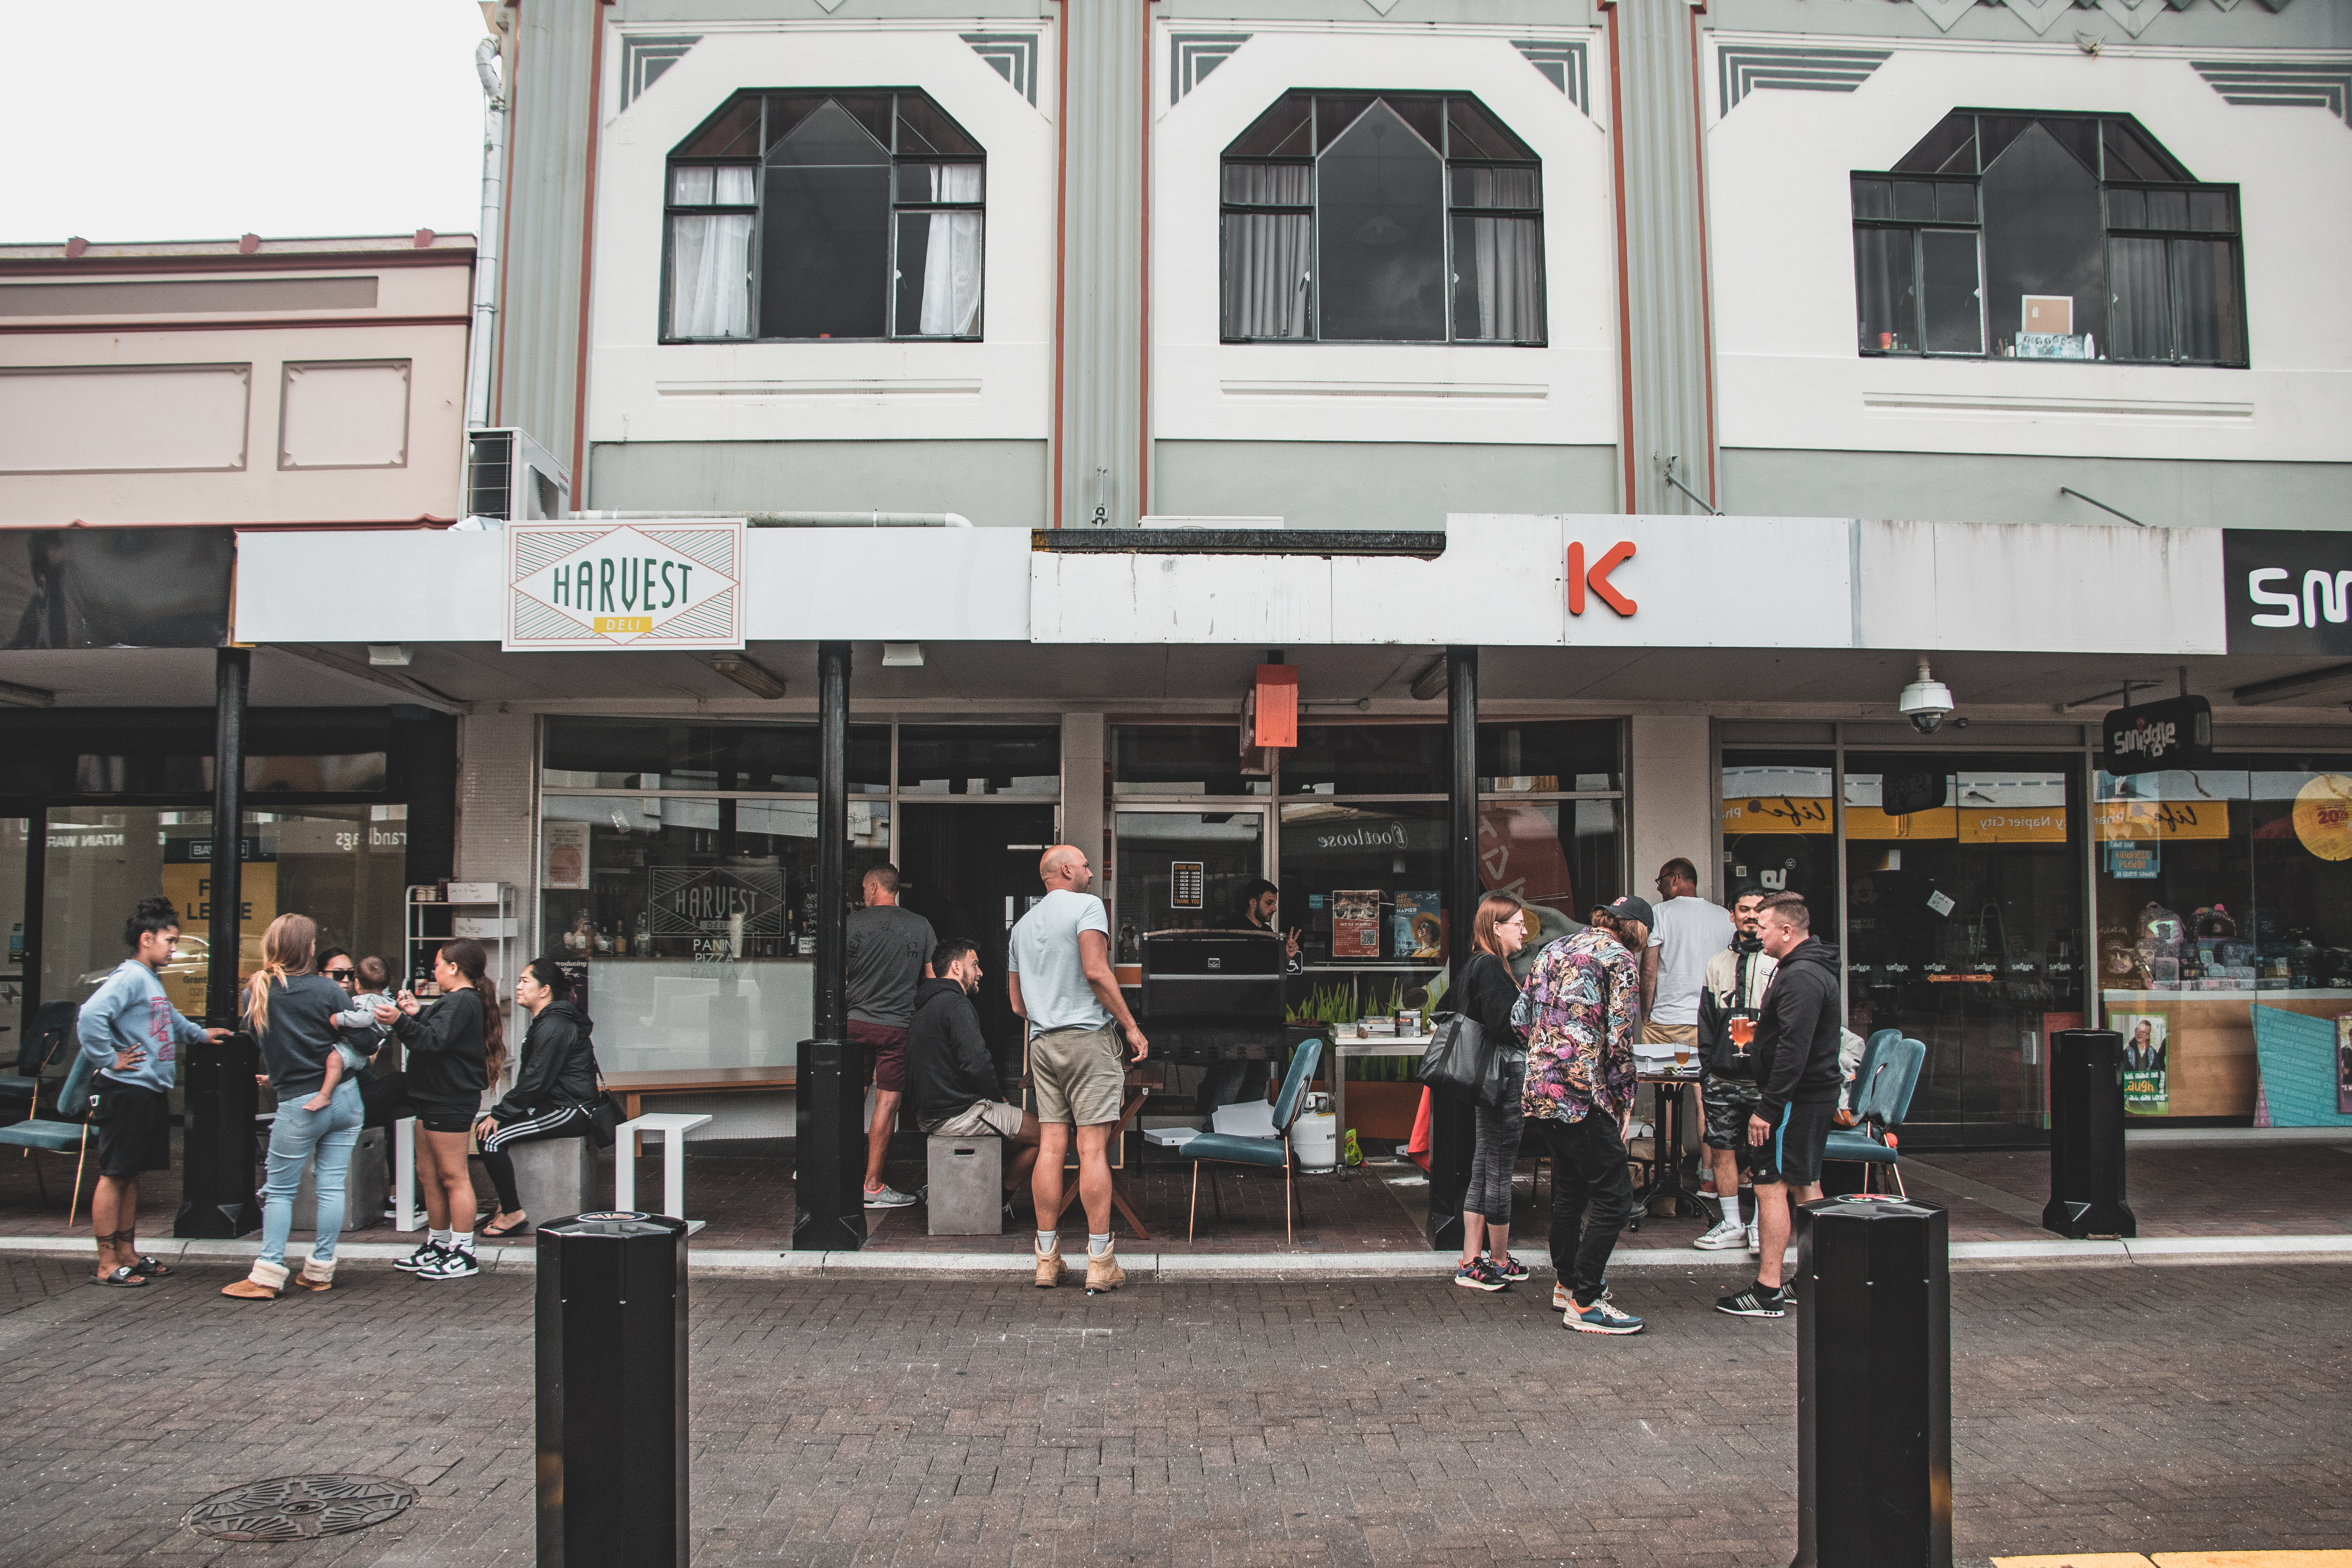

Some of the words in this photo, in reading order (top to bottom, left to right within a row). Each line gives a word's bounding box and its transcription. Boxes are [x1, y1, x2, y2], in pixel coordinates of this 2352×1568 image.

[553, 557, 693, 612] HARVEST
[1568, 541, 1638, 615] K
[606, 619, 641, 631] DELI
[2113, 717, 2176, 757] smiggle
[187, 902, 252, 920] LEE
[675, 886, 758, 918] HARVEST
[694, 953, 734, 964] PIZZA
